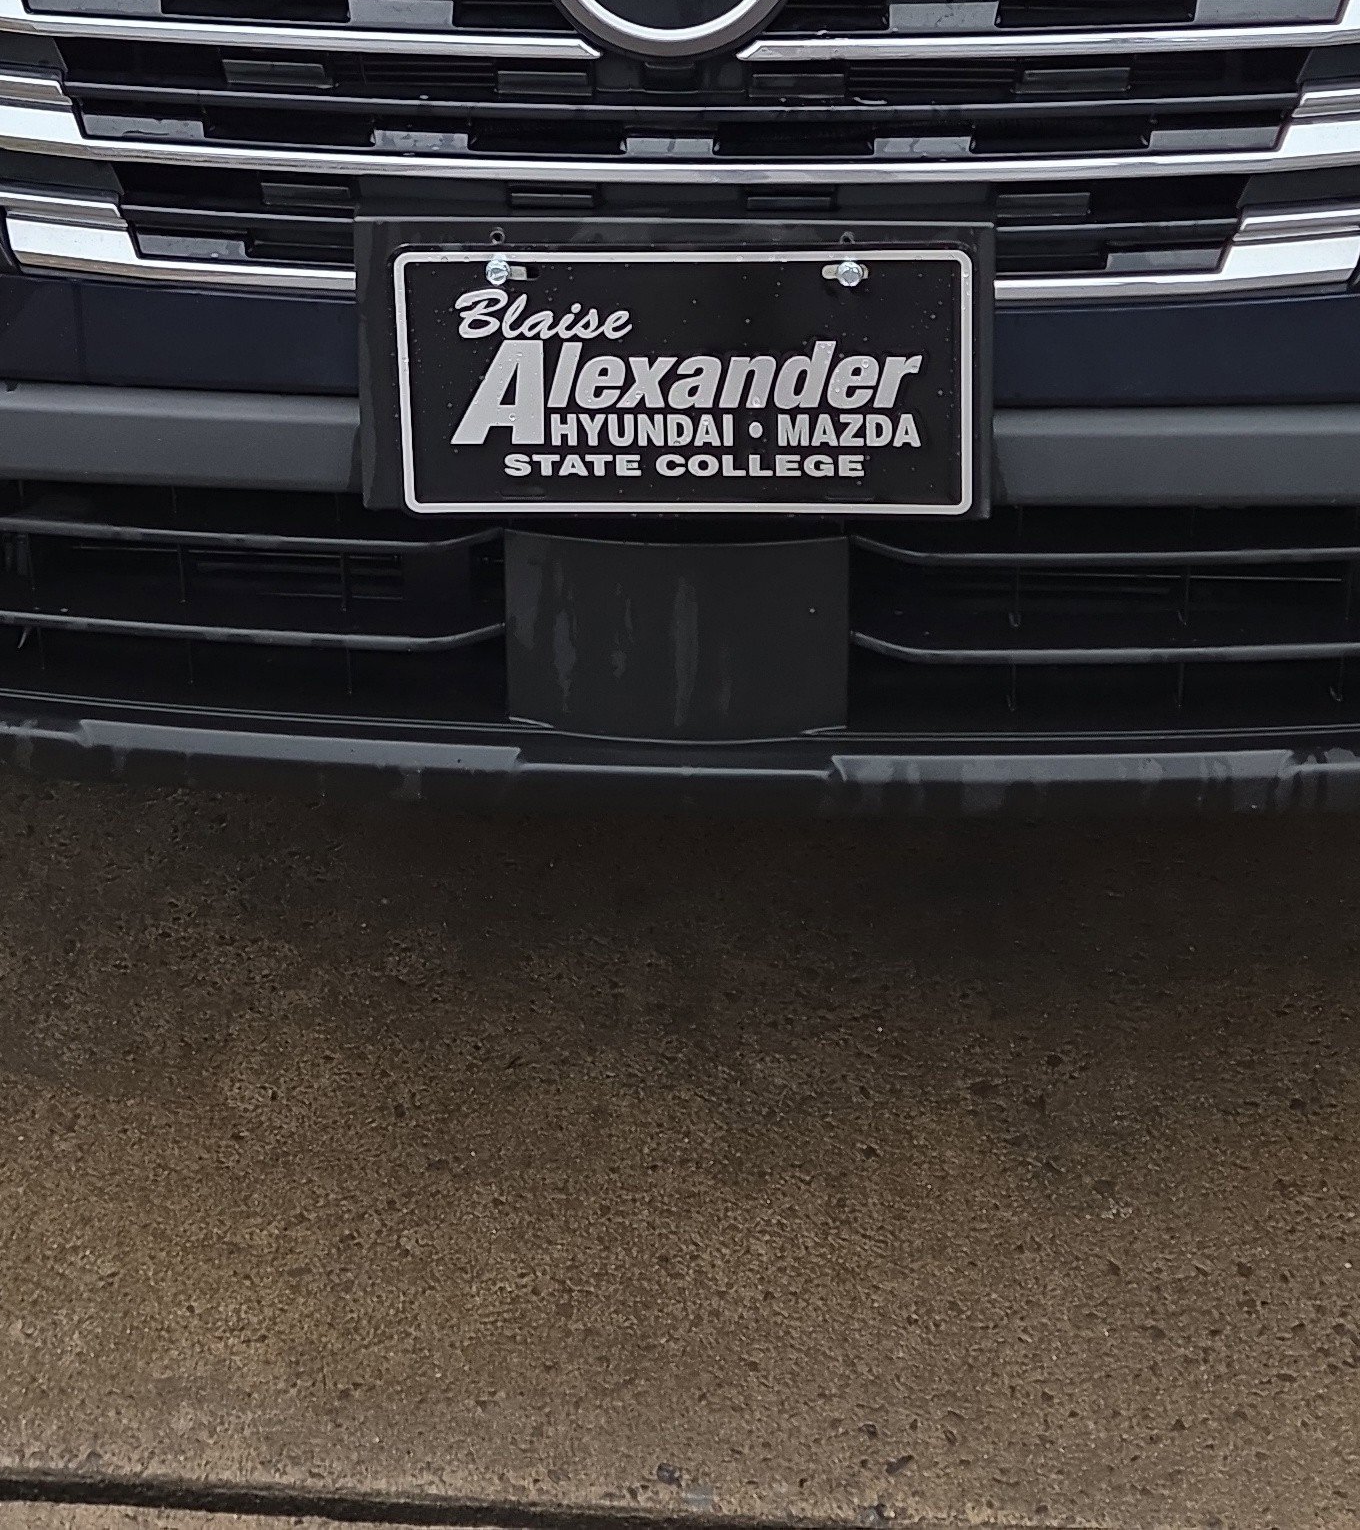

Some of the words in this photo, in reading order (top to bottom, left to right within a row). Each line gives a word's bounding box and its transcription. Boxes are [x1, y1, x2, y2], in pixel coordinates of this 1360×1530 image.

[455, 288, 633, 340] Blaise
[450, 340, 924, 445] Alexander
[550, 414, 734, 448] HYUNDAI
[777, 414, 921, 448] MAZDA
[503, 453, 642, 477] STATE
[655, 453, 865, 477] COLLEGE
